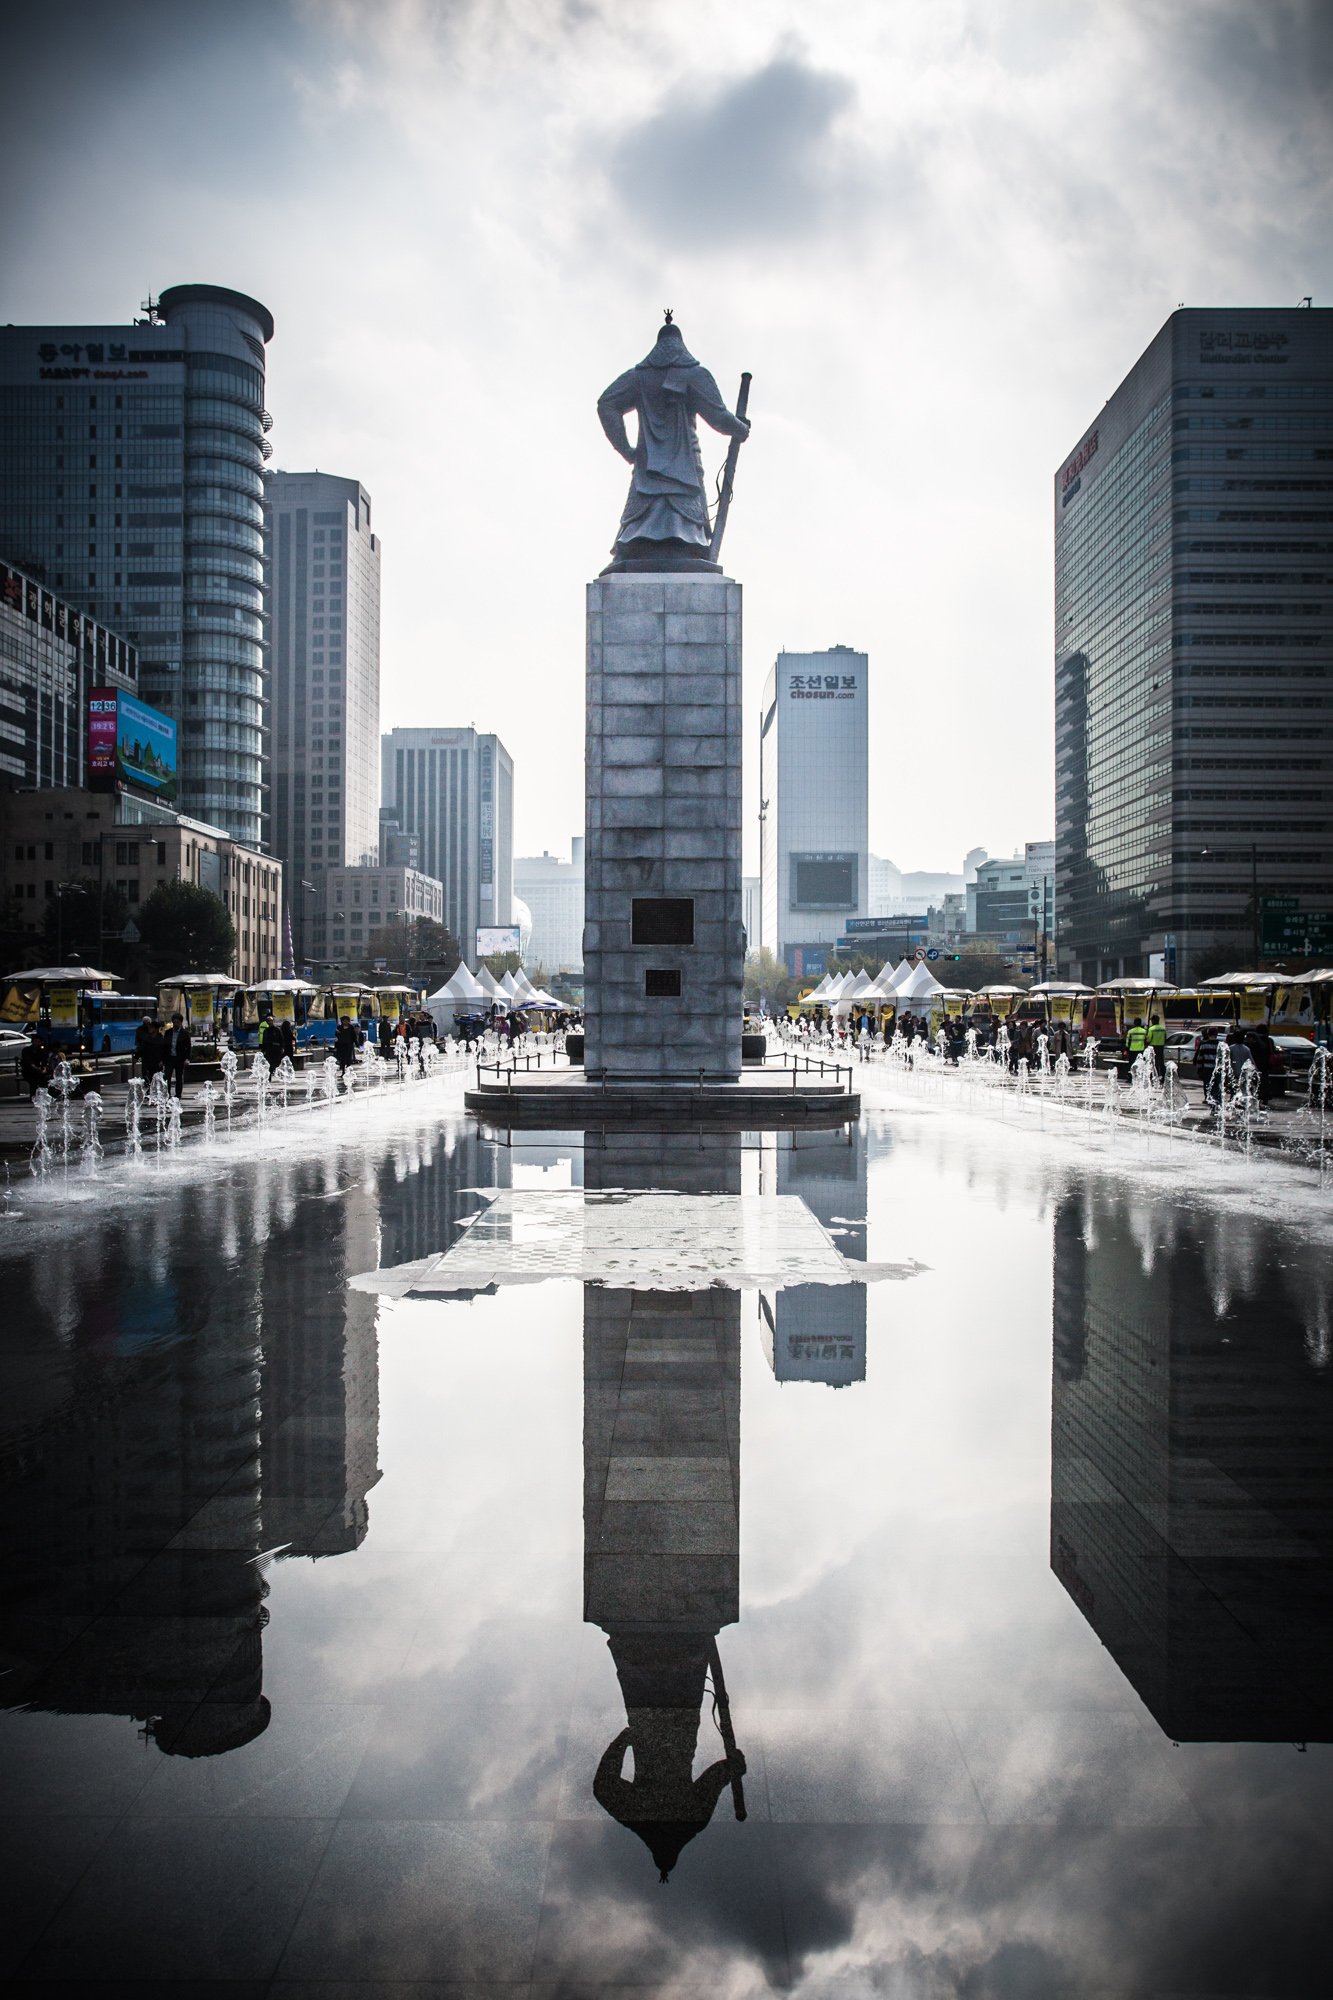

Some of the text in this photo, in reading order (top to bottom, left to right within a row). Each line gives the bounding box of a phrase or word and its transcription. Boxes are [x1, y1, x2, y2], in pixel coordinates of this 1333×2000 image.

[38, 342, 128, 363] 동아일보
[788, 675, 858, 690] 조선일보
[790, 689, 855, 700] chosun.com
